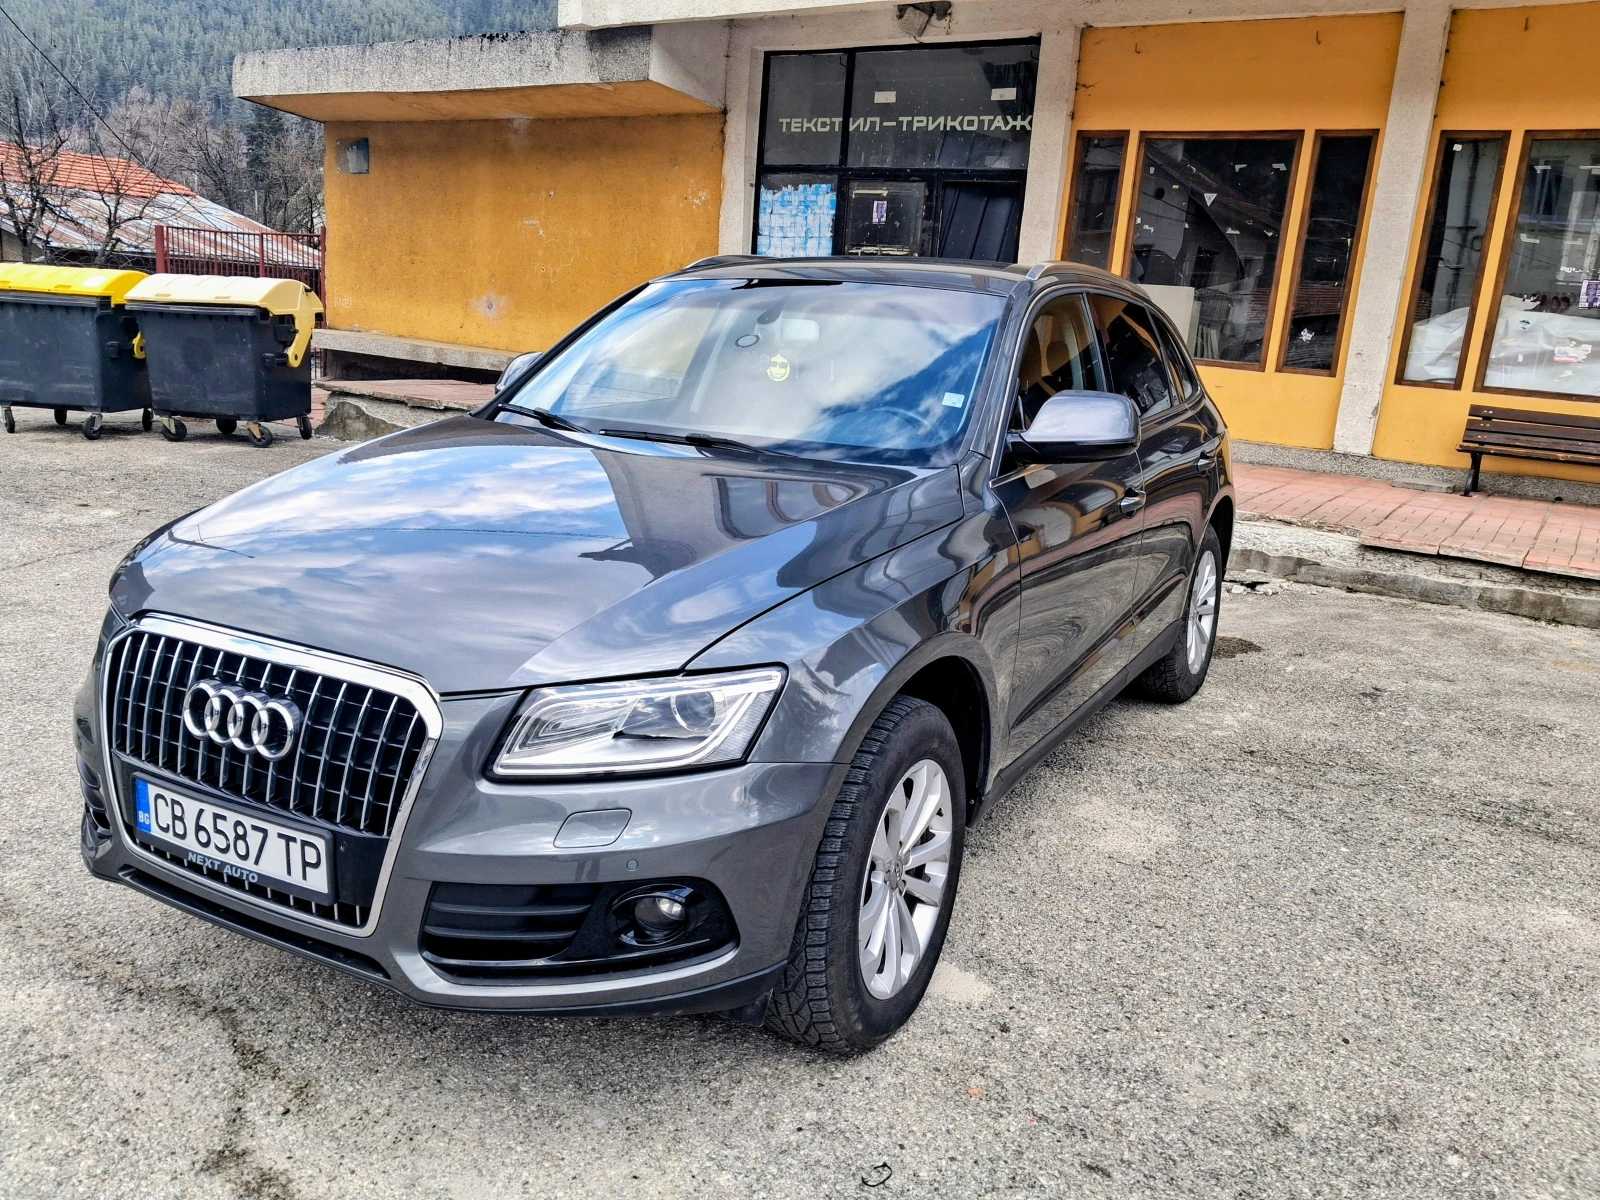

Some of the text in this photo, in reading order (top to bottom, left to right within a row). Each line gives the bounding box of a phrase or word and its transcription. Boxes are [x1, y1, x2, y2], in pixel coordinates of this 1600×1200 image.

[138, 811, 150, 825] BG
[194, 808, 269, 866] 6587
[188, 852, 258, 883] NEXT AUTO
